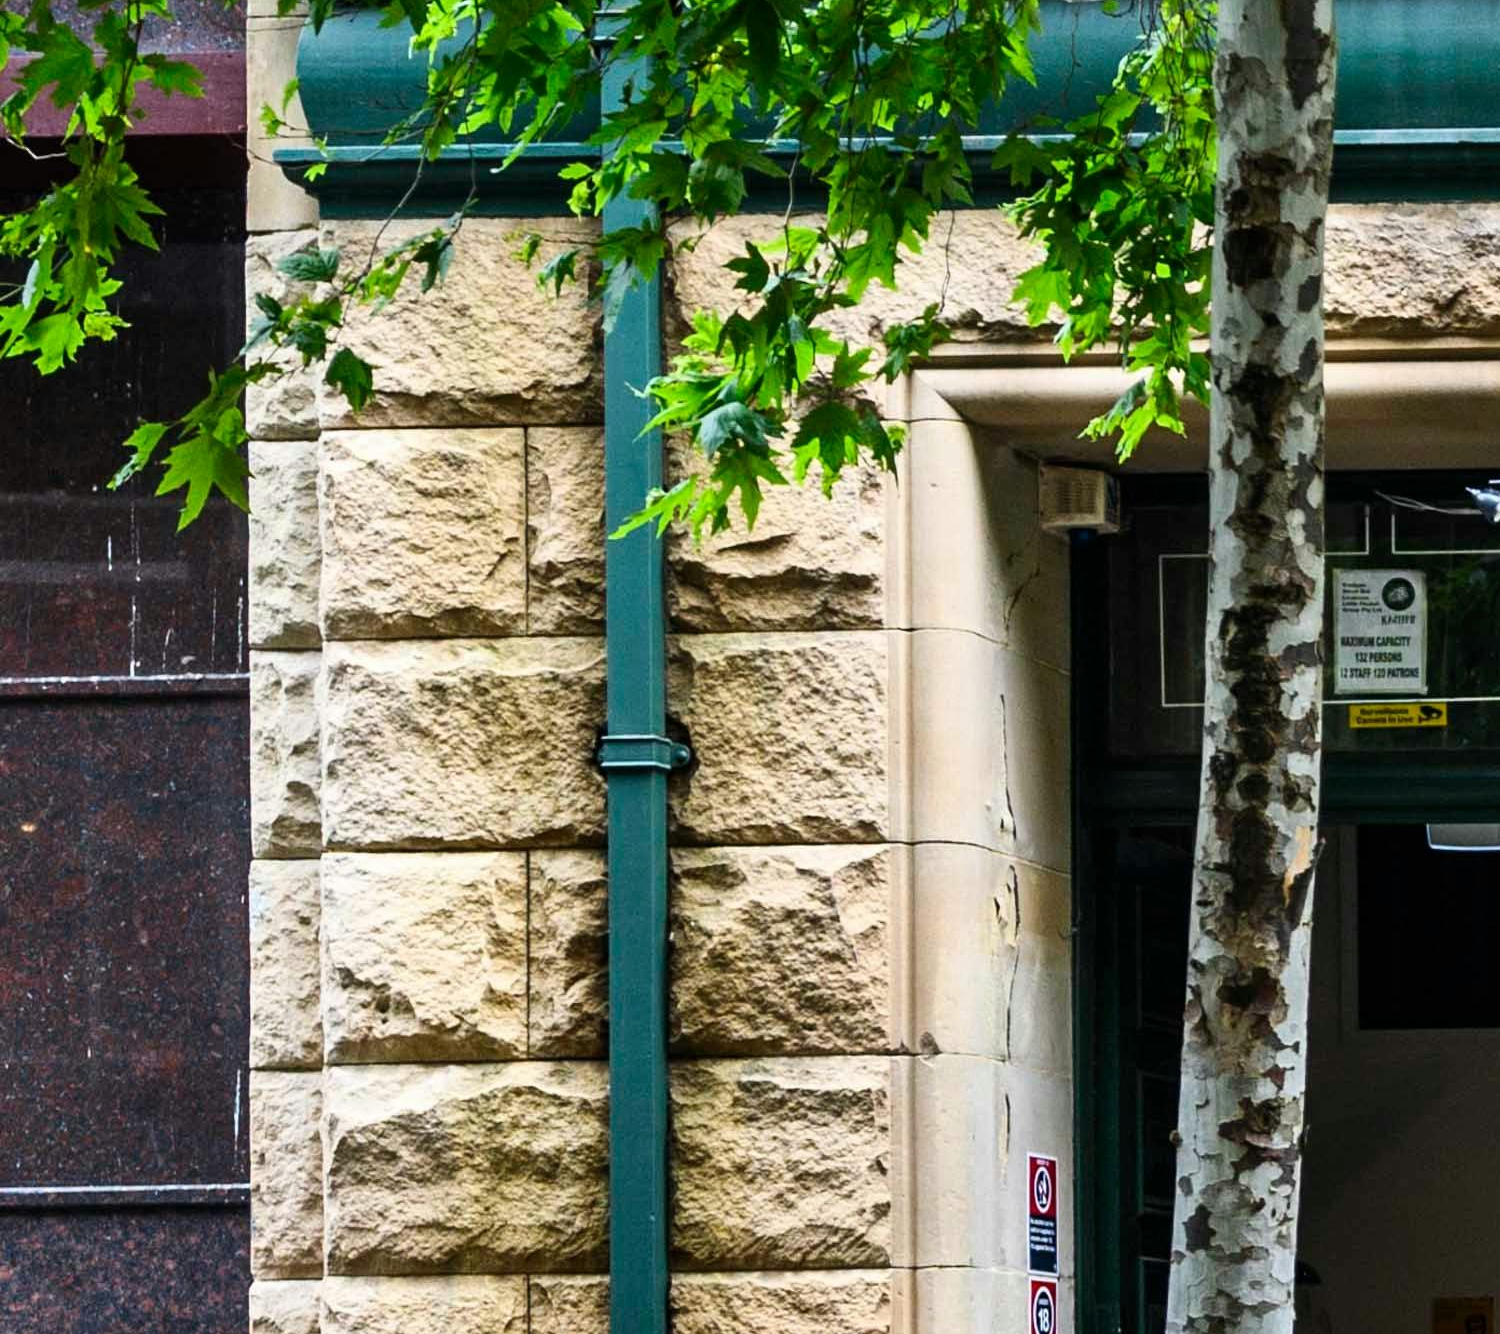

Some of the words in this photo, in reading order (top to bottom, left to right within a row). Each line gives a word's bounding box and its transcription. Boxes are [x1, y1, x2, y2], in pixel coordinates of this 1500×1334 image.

[1341, 637, 1375, 647] MAXIMUM
[1376, 636, 1411, 647] CAPACITY
[1369, 652, 1402, 662] PERSONS
[1350, 668, 1372, 678] STAFF
[1387, 667, 1419, 678] PATRONS
[1038, 1308, 1050, 1332] 18
